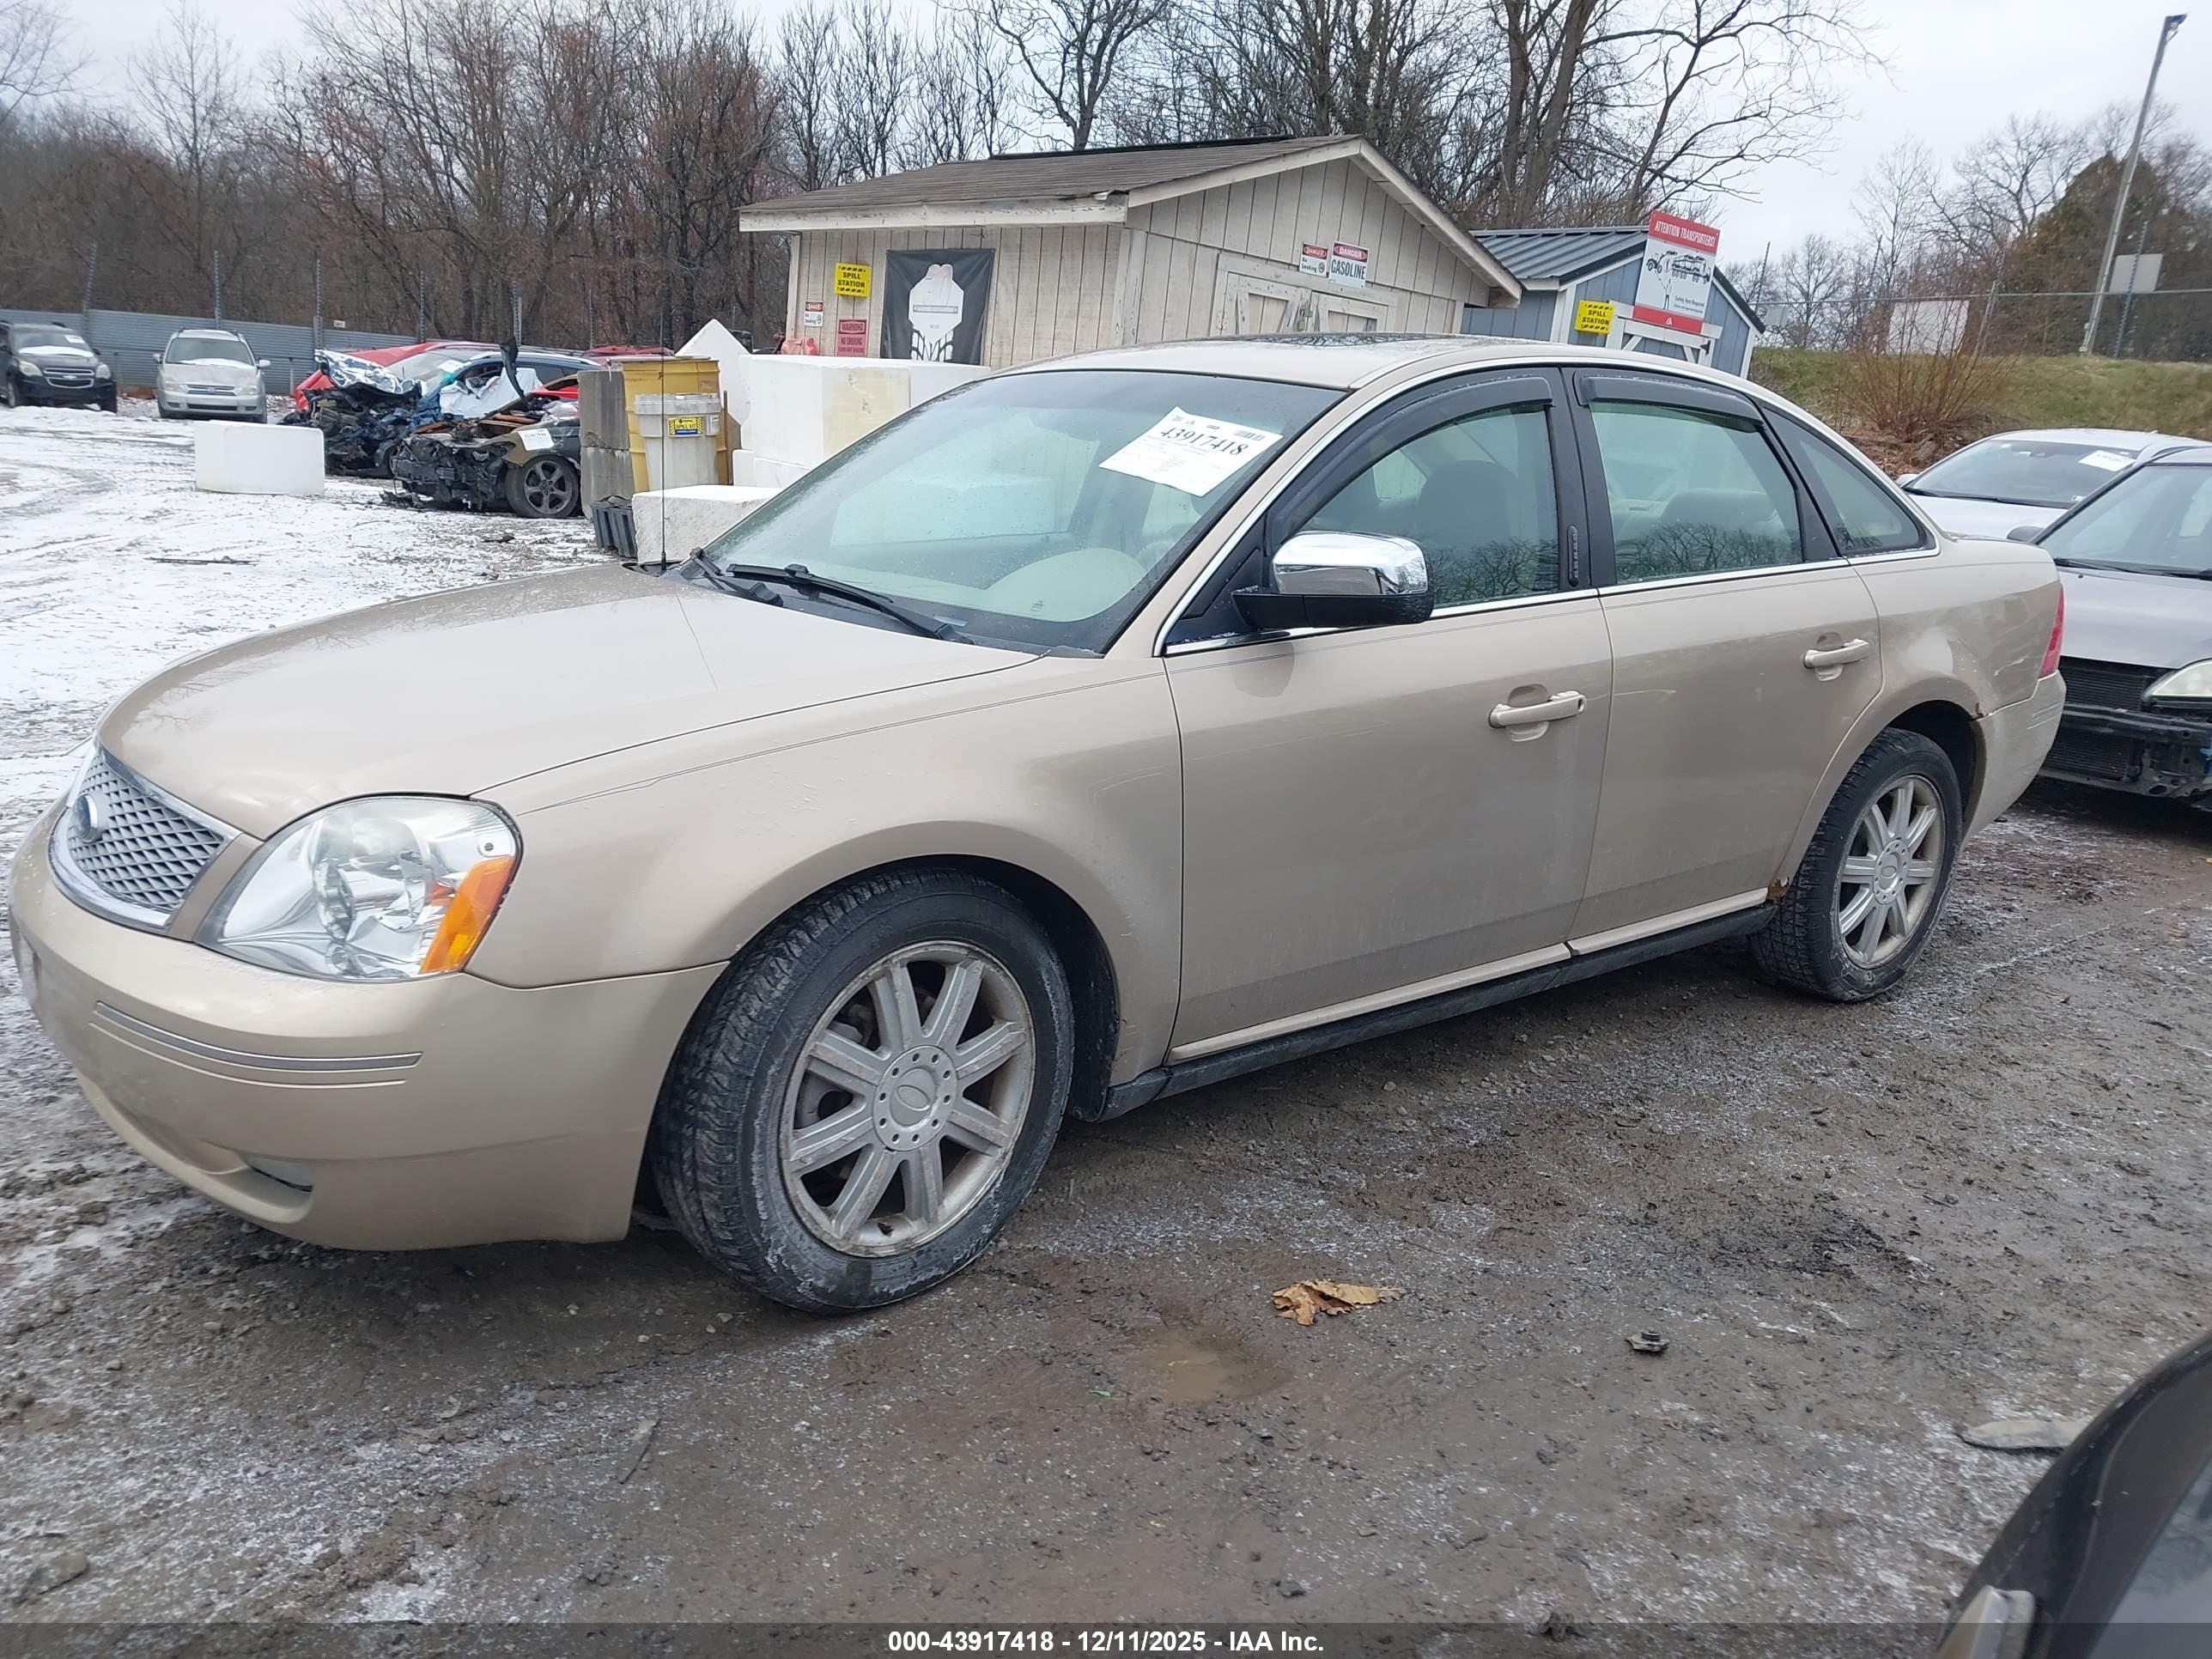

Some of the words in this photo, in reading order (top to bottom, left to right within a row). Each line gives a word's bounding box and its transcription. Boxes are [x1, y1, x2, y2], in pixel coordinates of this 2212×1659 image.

[1654, 221, 1680, 238] ATTENTION
[1306, 246, 1324, 257] DANGER
[1340, 246, 1363, 259] DANGER
[1331, 258, 1366, 280] GASOLINE
[842, 271, 860, 280] SPILL
[837, 279, 866, 288] STATION
[1588, 309, 1607, 318] SPILL
[1582, 316, 1609, 325] STATION
[1160, 427, 1249, 455] 43917418
